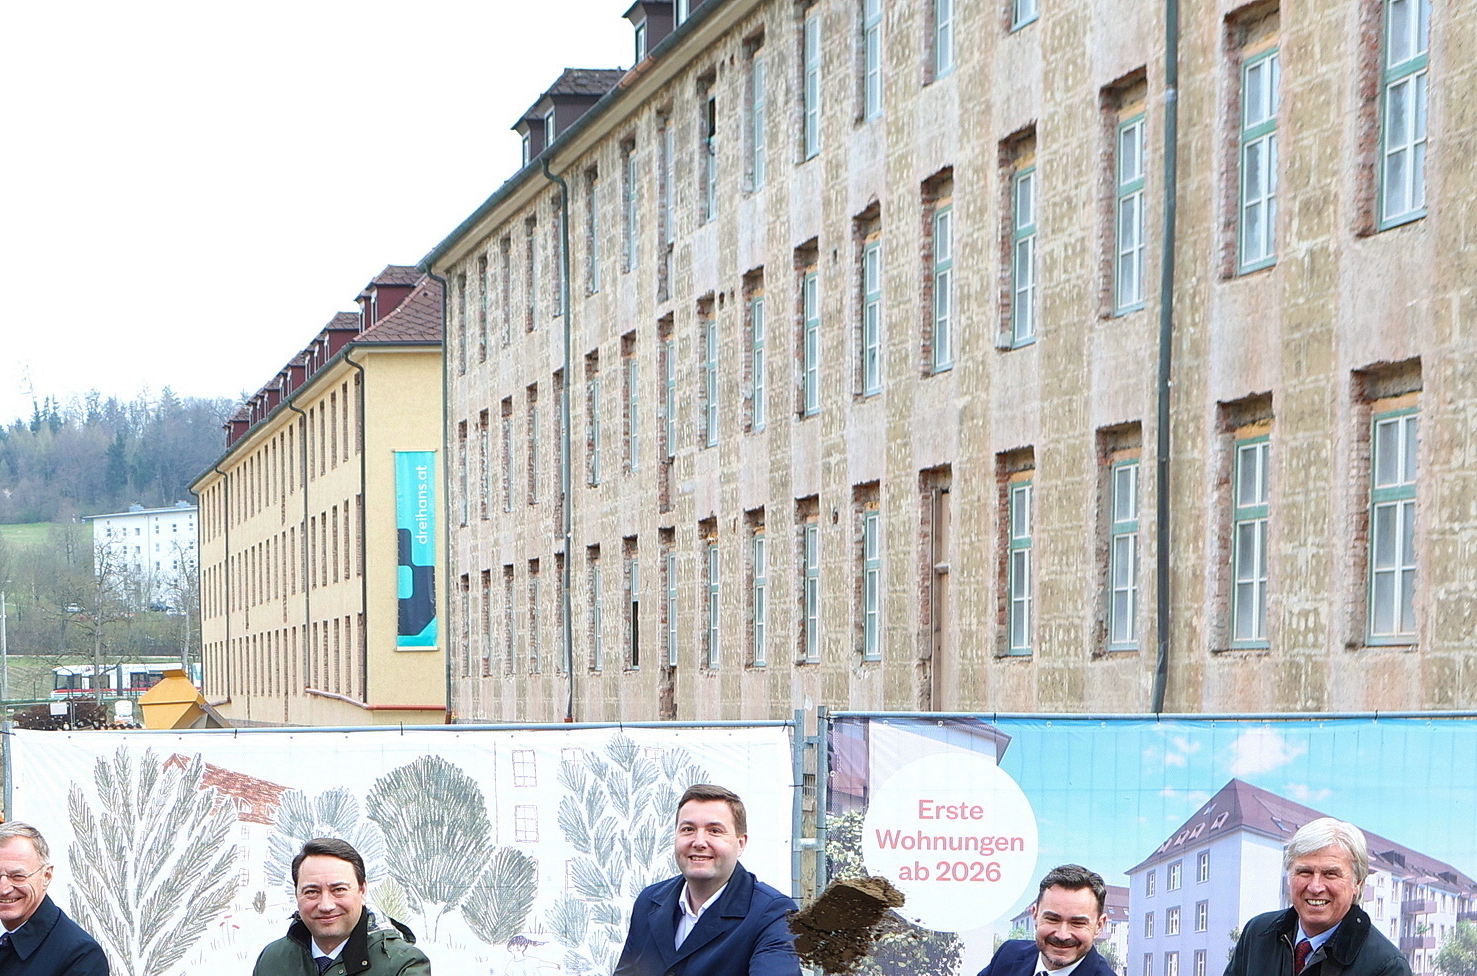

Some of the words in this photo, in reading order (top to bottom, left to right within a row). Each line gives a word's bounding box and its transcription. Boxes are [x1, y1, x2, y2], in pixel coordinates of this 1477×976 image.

[415, 465, 428, 545] dreihans.at
[918, 799, 984, 820] Erste
[875, 828, 1025, 857] Wohnungen
[898, 861, 930, 882] ab
[935, 861, 1001, 882] 2026
